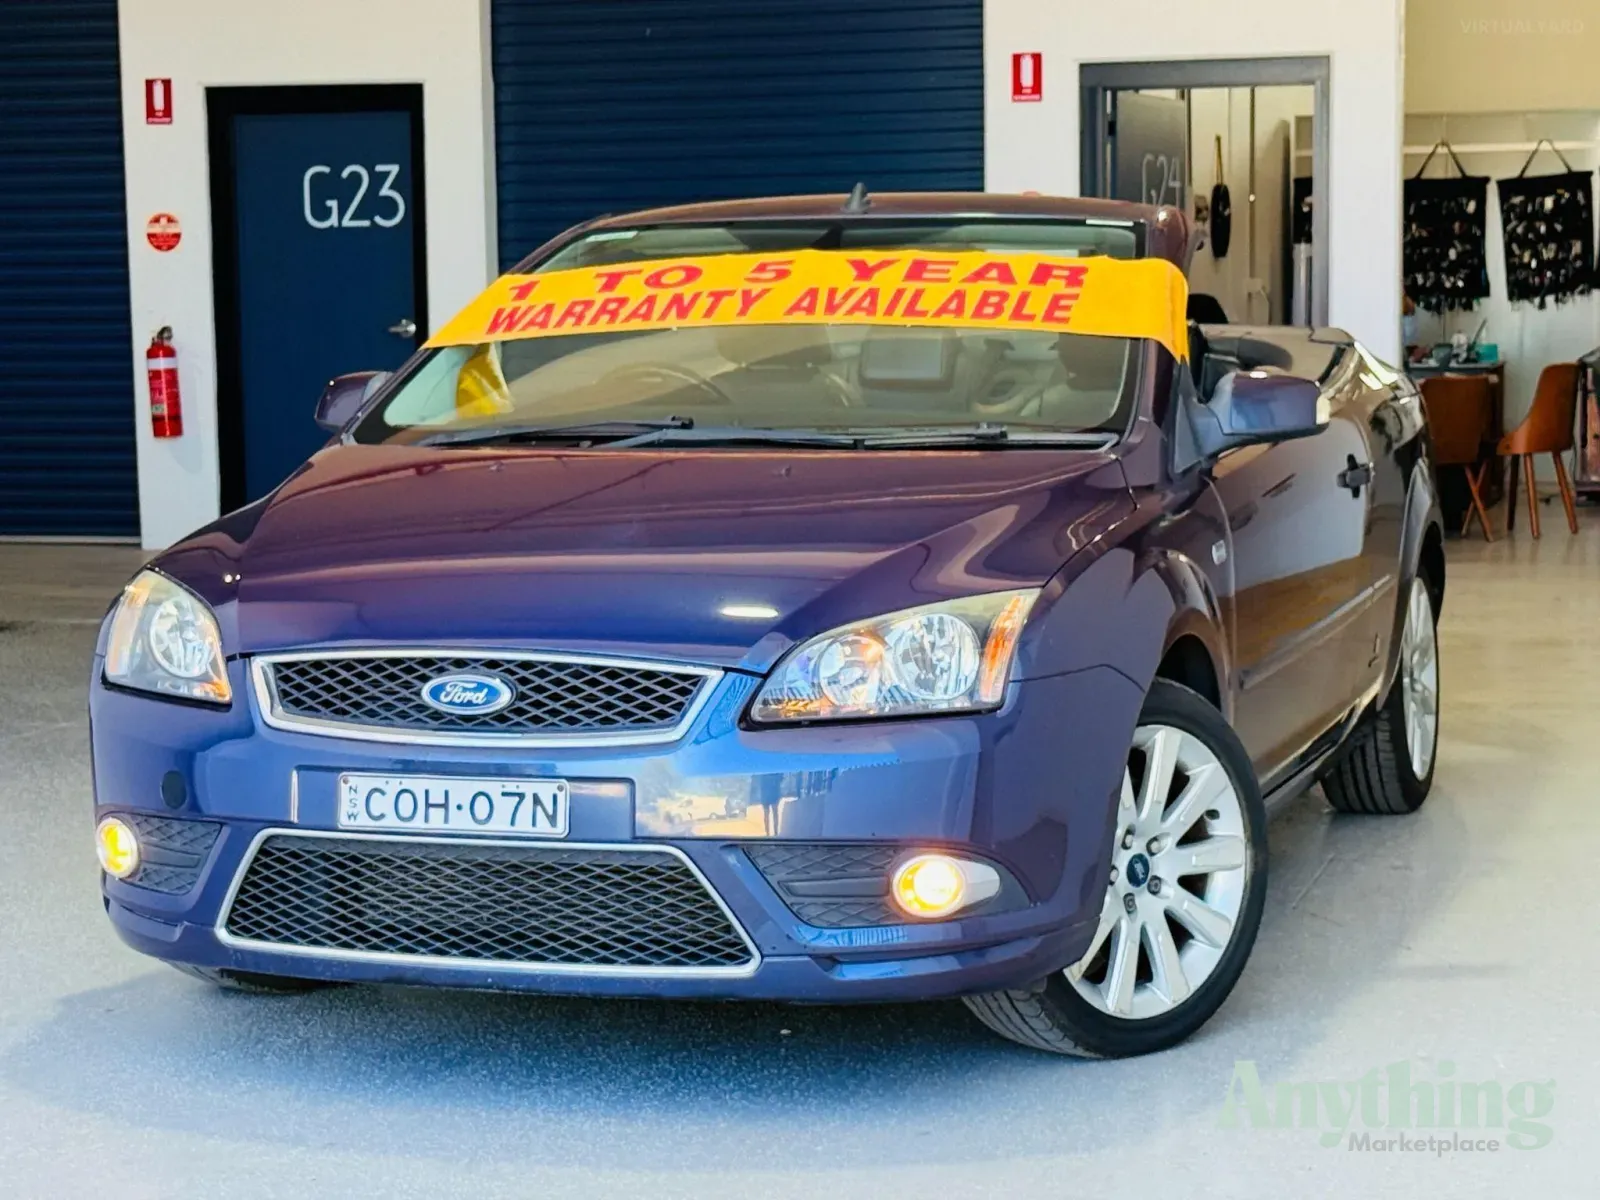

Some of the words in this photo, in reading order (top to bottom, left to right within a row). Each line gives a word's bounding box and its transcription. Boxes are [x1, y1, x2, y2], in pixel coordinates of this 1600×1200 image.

[303, 164, 406, 229] G23
[509, 280, 540, 301] 1
[594, 264, 704, 293] TO
[743, 259, 795, 283] 5
[846, 258, 1089, 289] YEAR
[485, 287, 772, 335] WARRANTY
[783, 287, 1080, 324] AVAILABLE
[440, 681, 489, 704] Ford
